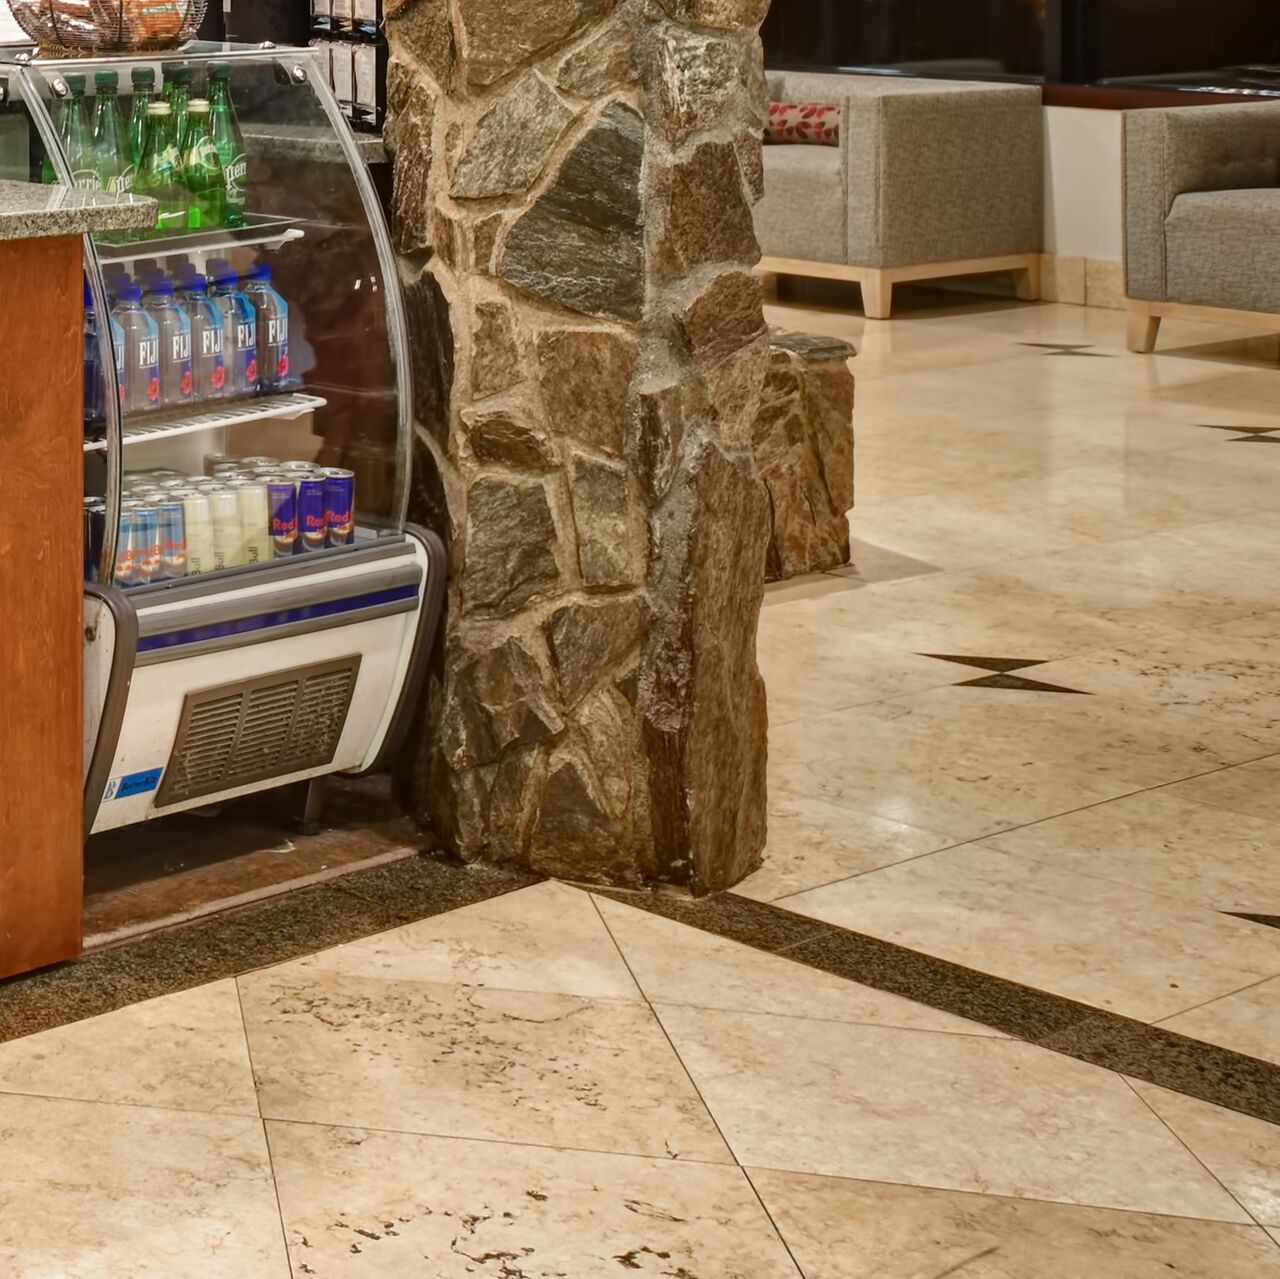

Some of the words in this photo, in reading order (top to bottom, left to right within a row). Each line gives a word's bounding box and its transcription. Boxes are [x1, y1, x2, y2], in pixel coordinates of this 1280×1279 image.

[203, 328, 224, 354] FIJI
[273, 517, 296, 531] Red
[326, 510, 350, 523] Red
[215, 551, 225, 571] Bull
